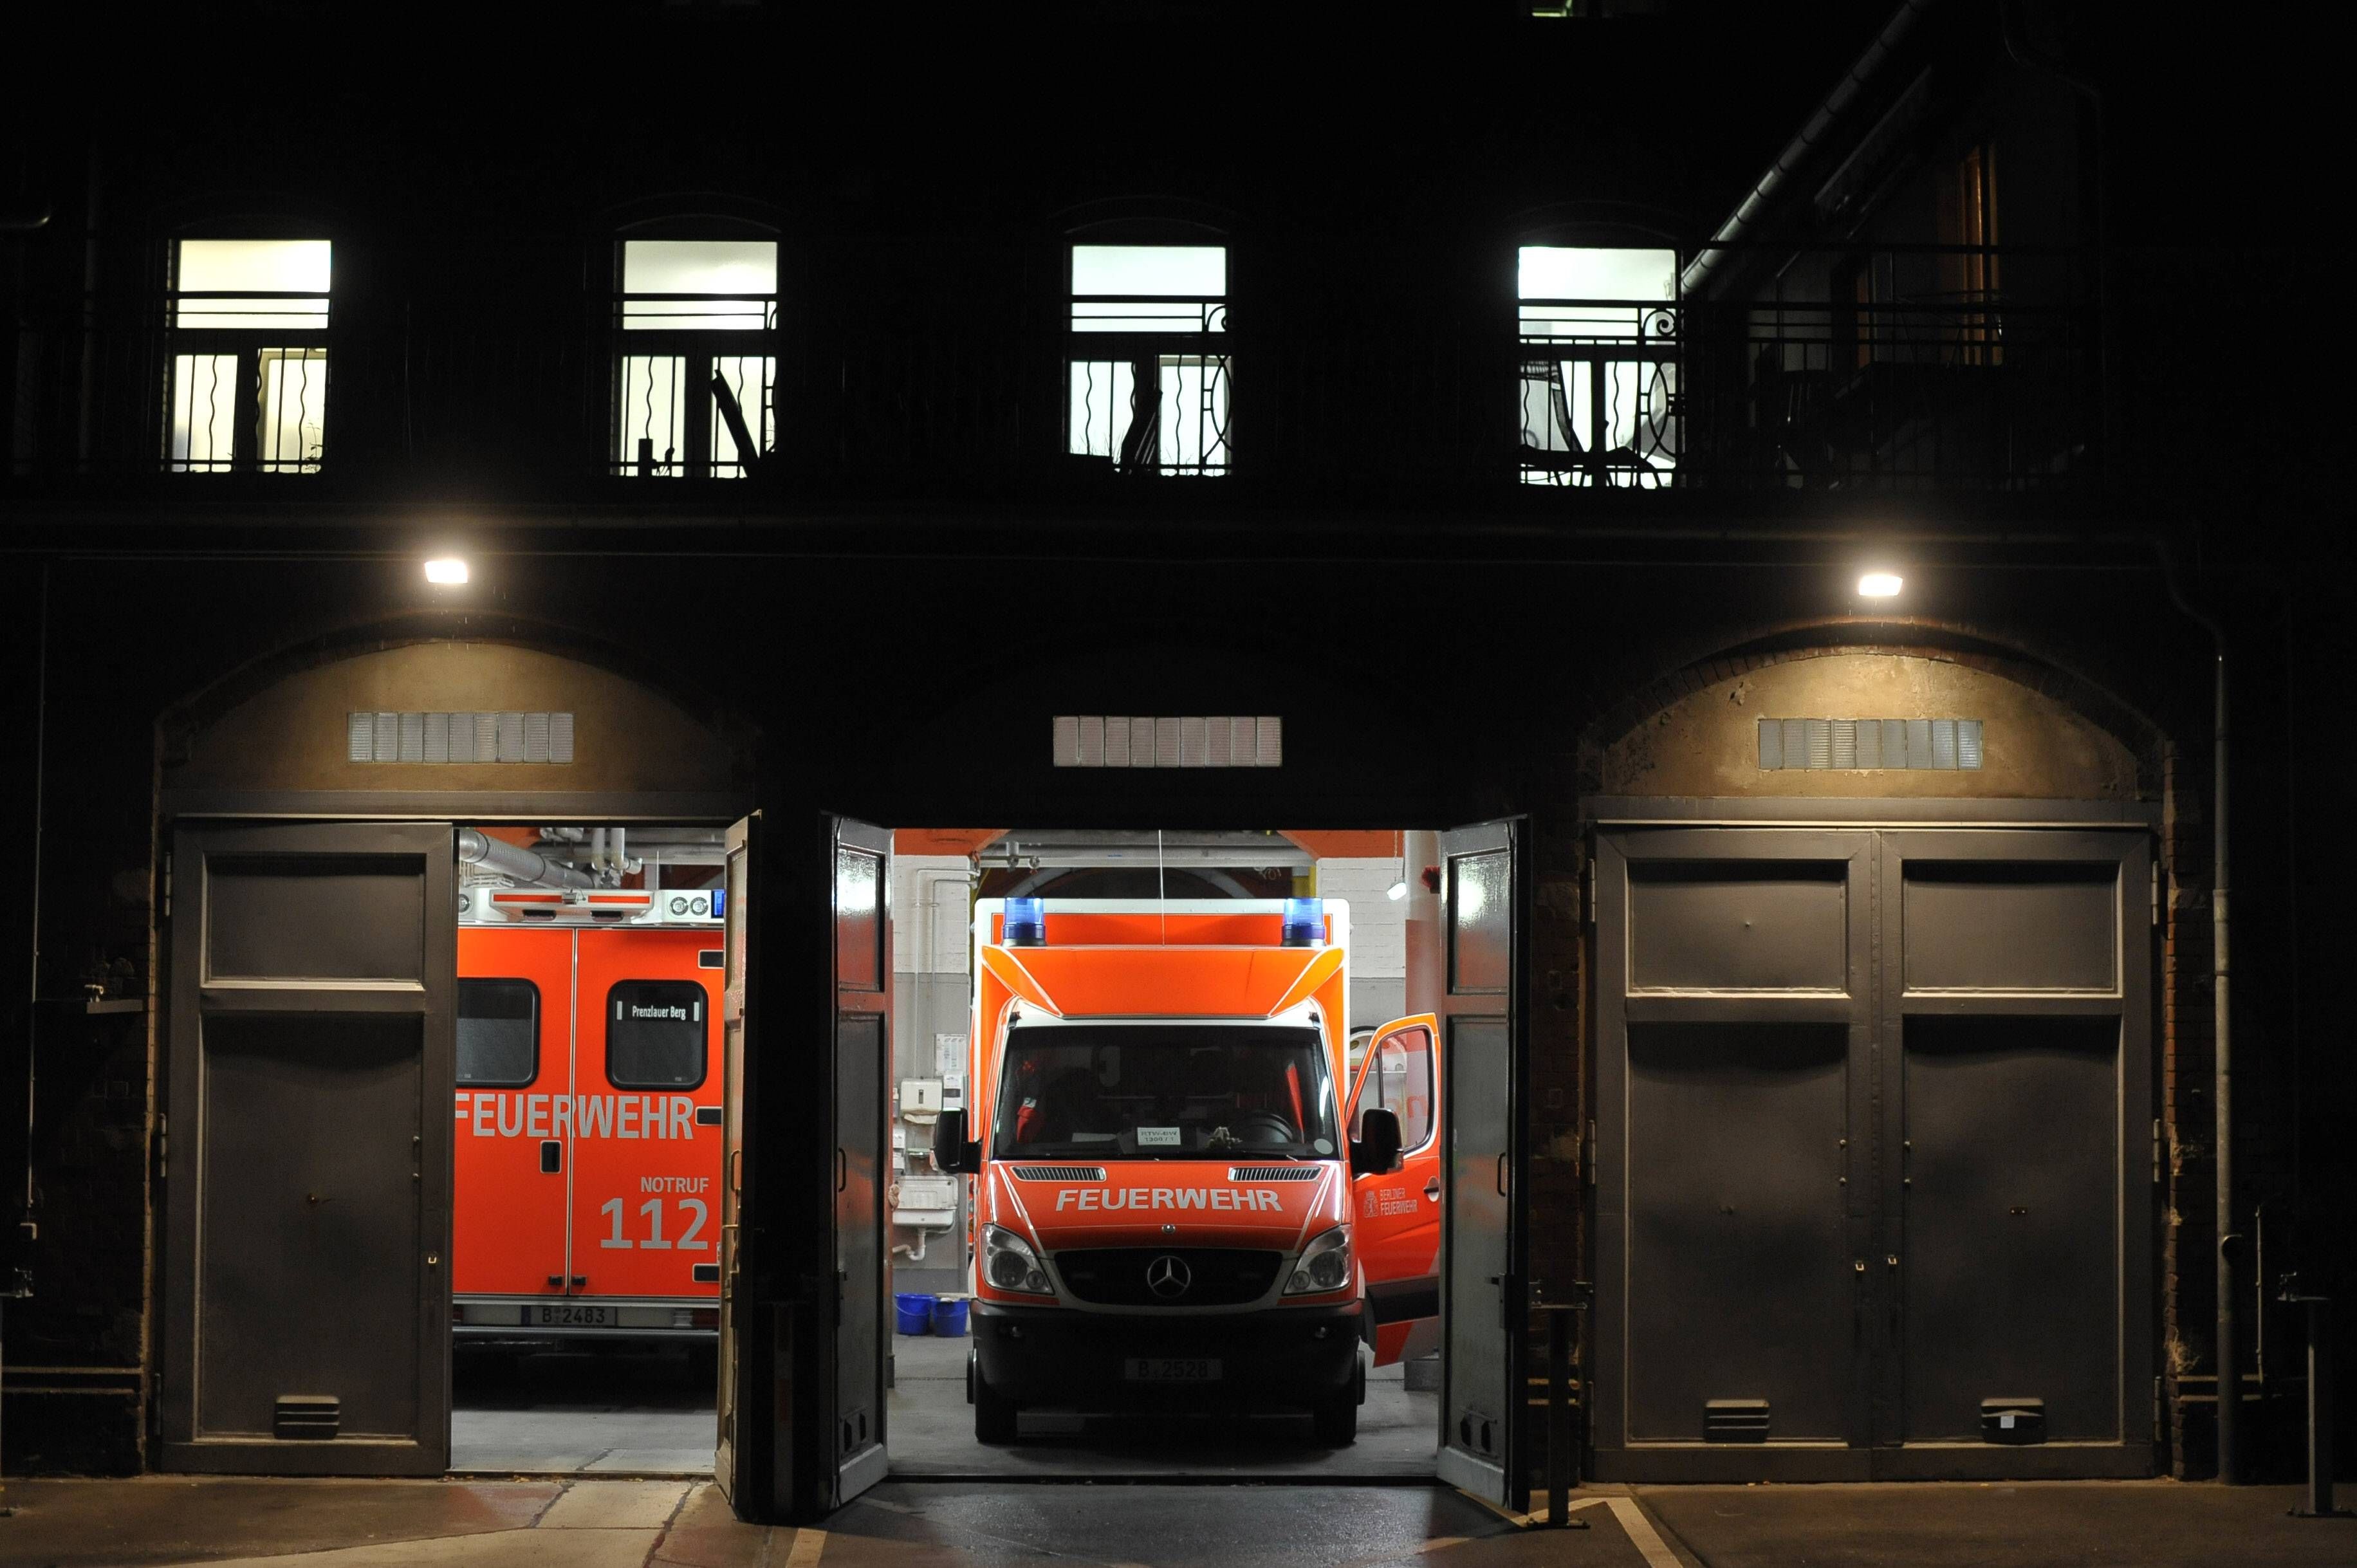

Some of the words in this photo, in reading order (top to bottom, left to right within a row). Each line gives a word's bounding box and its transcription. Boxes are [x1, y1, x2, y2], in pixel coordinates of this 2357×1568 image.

[632, 1005, 669, 1017] Prenzlauer
[670, 1006, 686, 1020] Berg
[641, 1177, 709, 1194] NOTRUF
[1055, 1188, 1283, 1212] FEUERWEHR
[600, 1197, 708, 1250] 112
[563, 1309, 605, 1324] 2483
[1163, 1361, 1208, 1378] 2528
